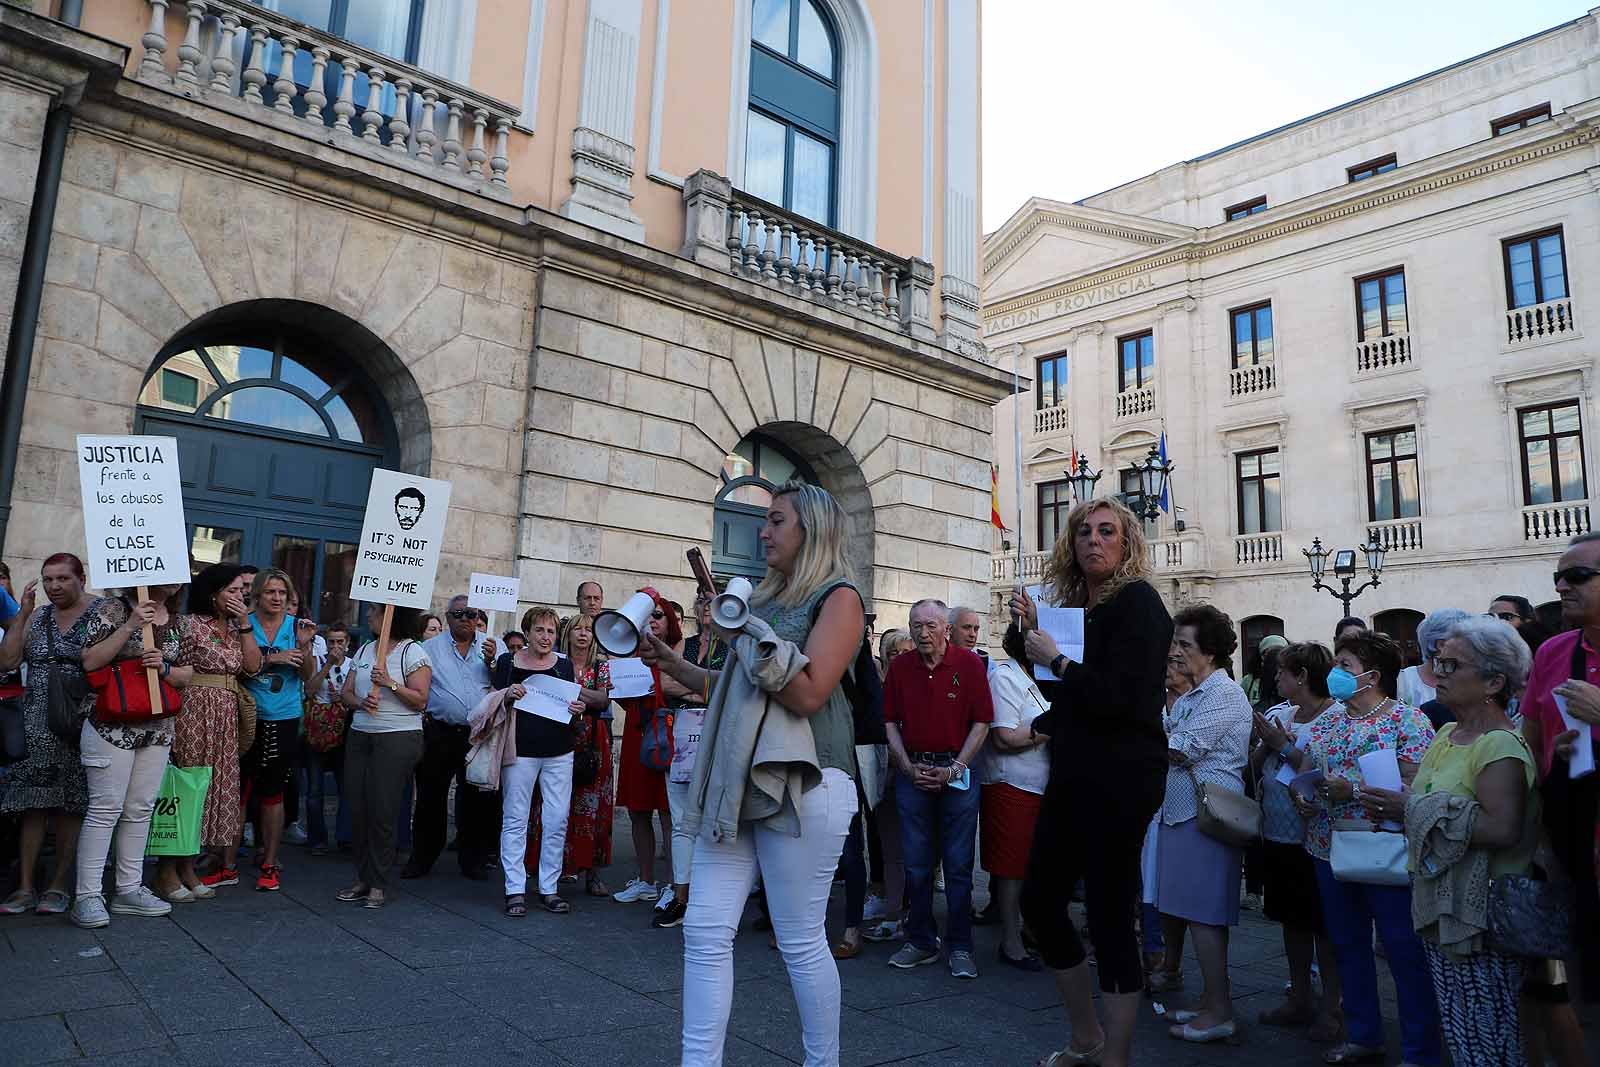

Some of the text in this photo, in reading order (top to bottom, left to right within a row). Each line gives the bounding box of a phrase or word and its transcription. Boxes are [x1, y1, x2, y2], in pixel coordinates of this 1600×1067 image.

[1055, 274, 1155, 314] PROVINCIAL
[83, 446, 164, 464] JUSTICIA
[100, 466, 151, 485] frente a
[97, 491, 164, 504] los abusos
[109, 514, 145, 527] de la
[105, 535, 155, 549] CLASE
[371, 532, 428, 551] IT'S NOT
[106, 555, 165, 573] MÉDICA
[363, 550, 425, 568] PSYCHIATRIC
[358, 575, 418, 595] IT'S LYME
[474, 585, 514, 596] LIBERTAD
